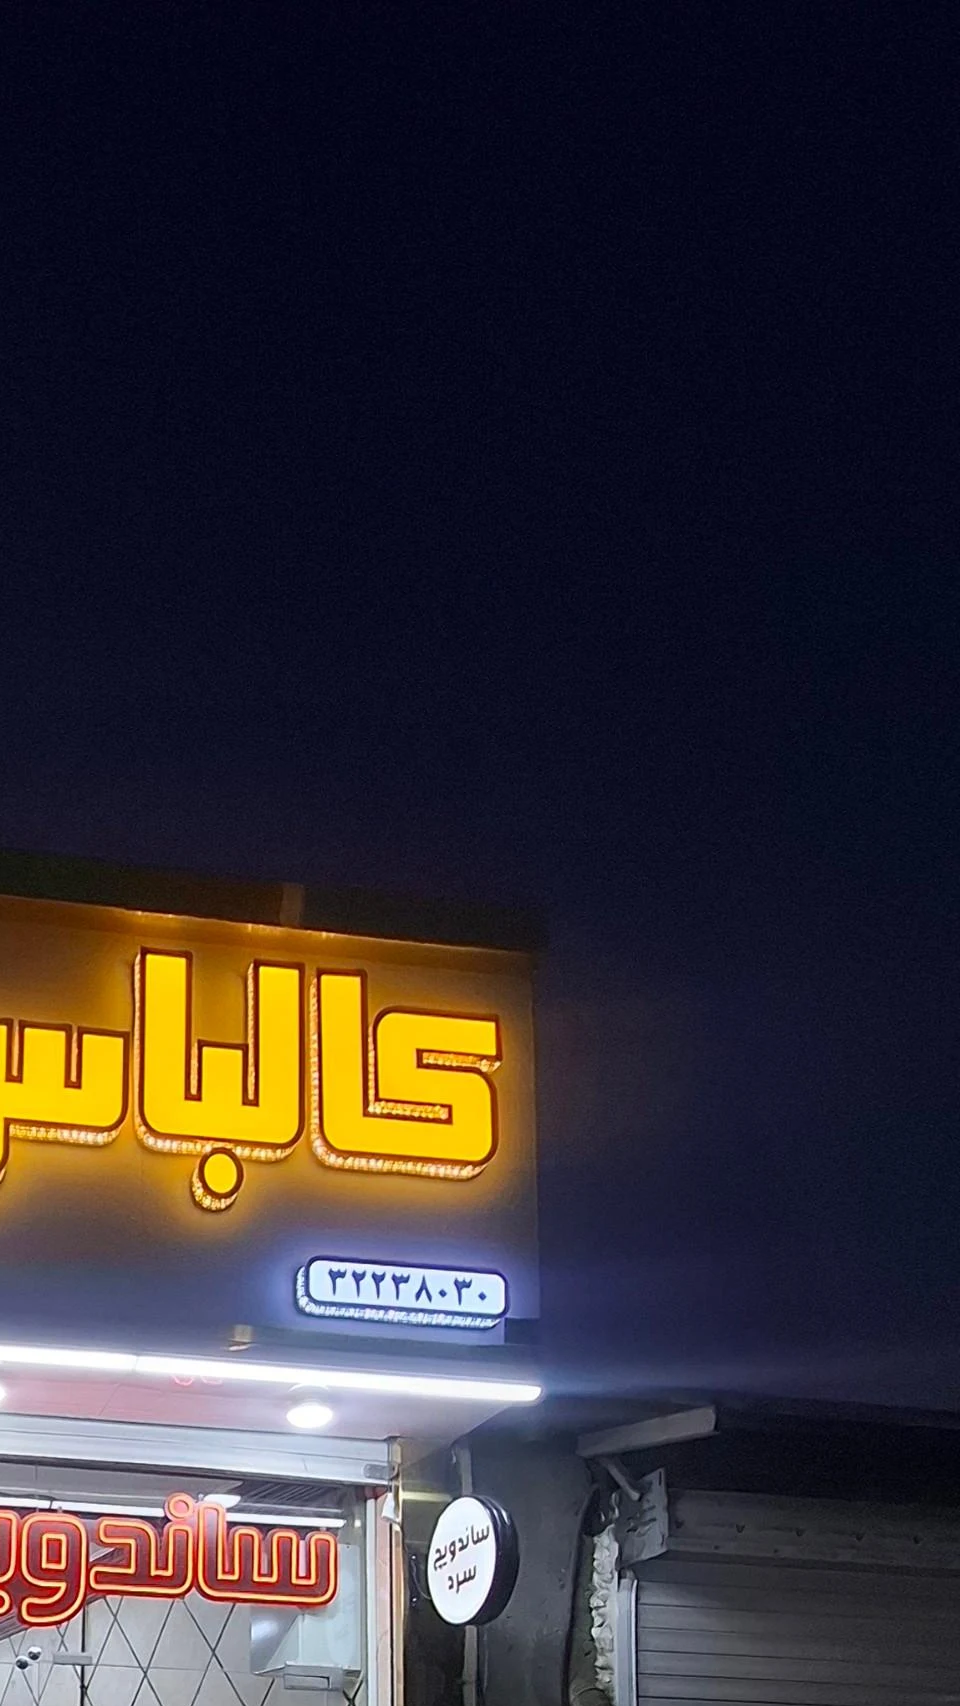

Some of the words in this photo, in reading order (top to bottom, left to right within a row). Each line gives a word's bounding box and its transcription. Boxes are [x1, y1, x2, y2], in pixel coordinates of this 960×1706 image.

[328, 1267, 490, 1306] ۳۲۲۳۸۰۳۰
[433, 1524, 490, 1572] ساندویچ
[447, 1564, 477, 1594] سرد
